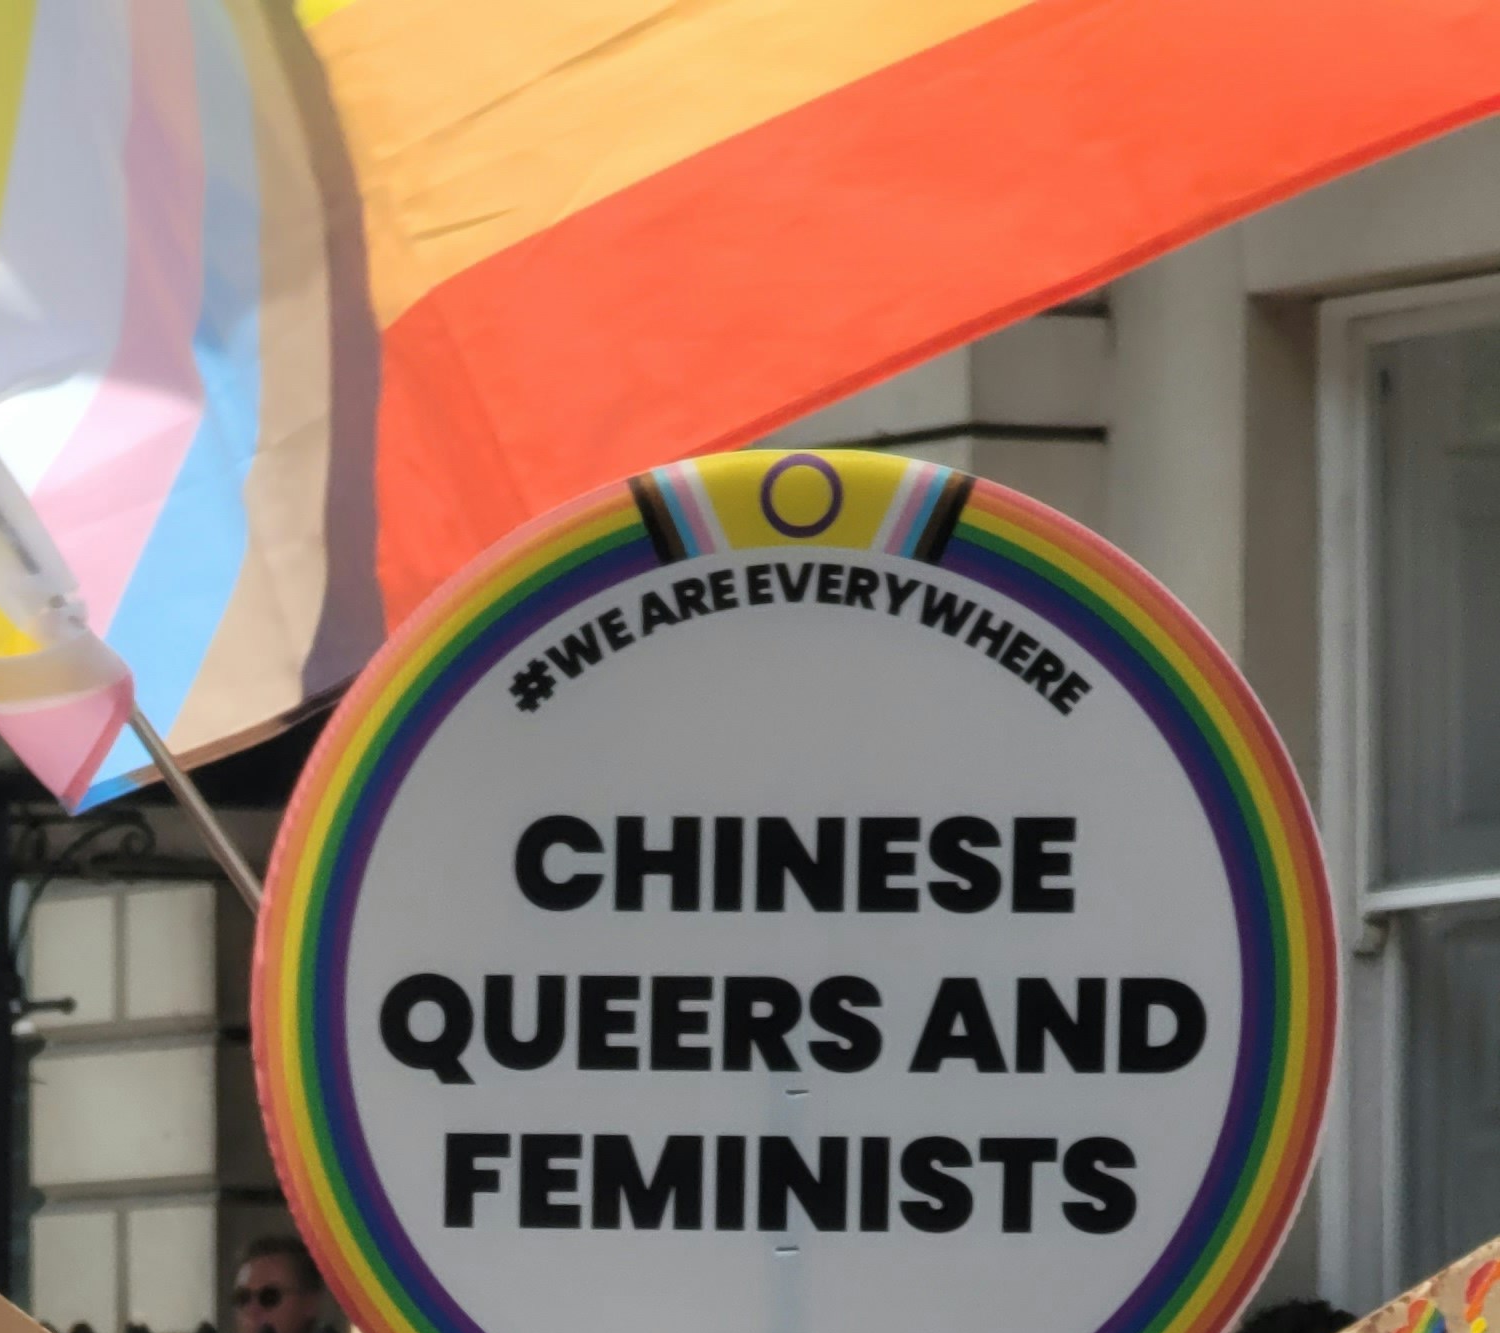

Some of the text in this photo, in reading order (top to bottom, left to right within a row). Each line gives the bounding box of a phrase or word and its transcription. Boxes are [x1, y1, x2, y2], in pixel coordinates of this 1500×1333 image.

[508, 561, 1093, 716] #WE ARE EVERYWHERE
[513, 814, 1077, 915] CHINESE
[378, 972, 1208, 1086] QUEERS AND
[442, 1132, 1139, 1234] FEMINISTS
